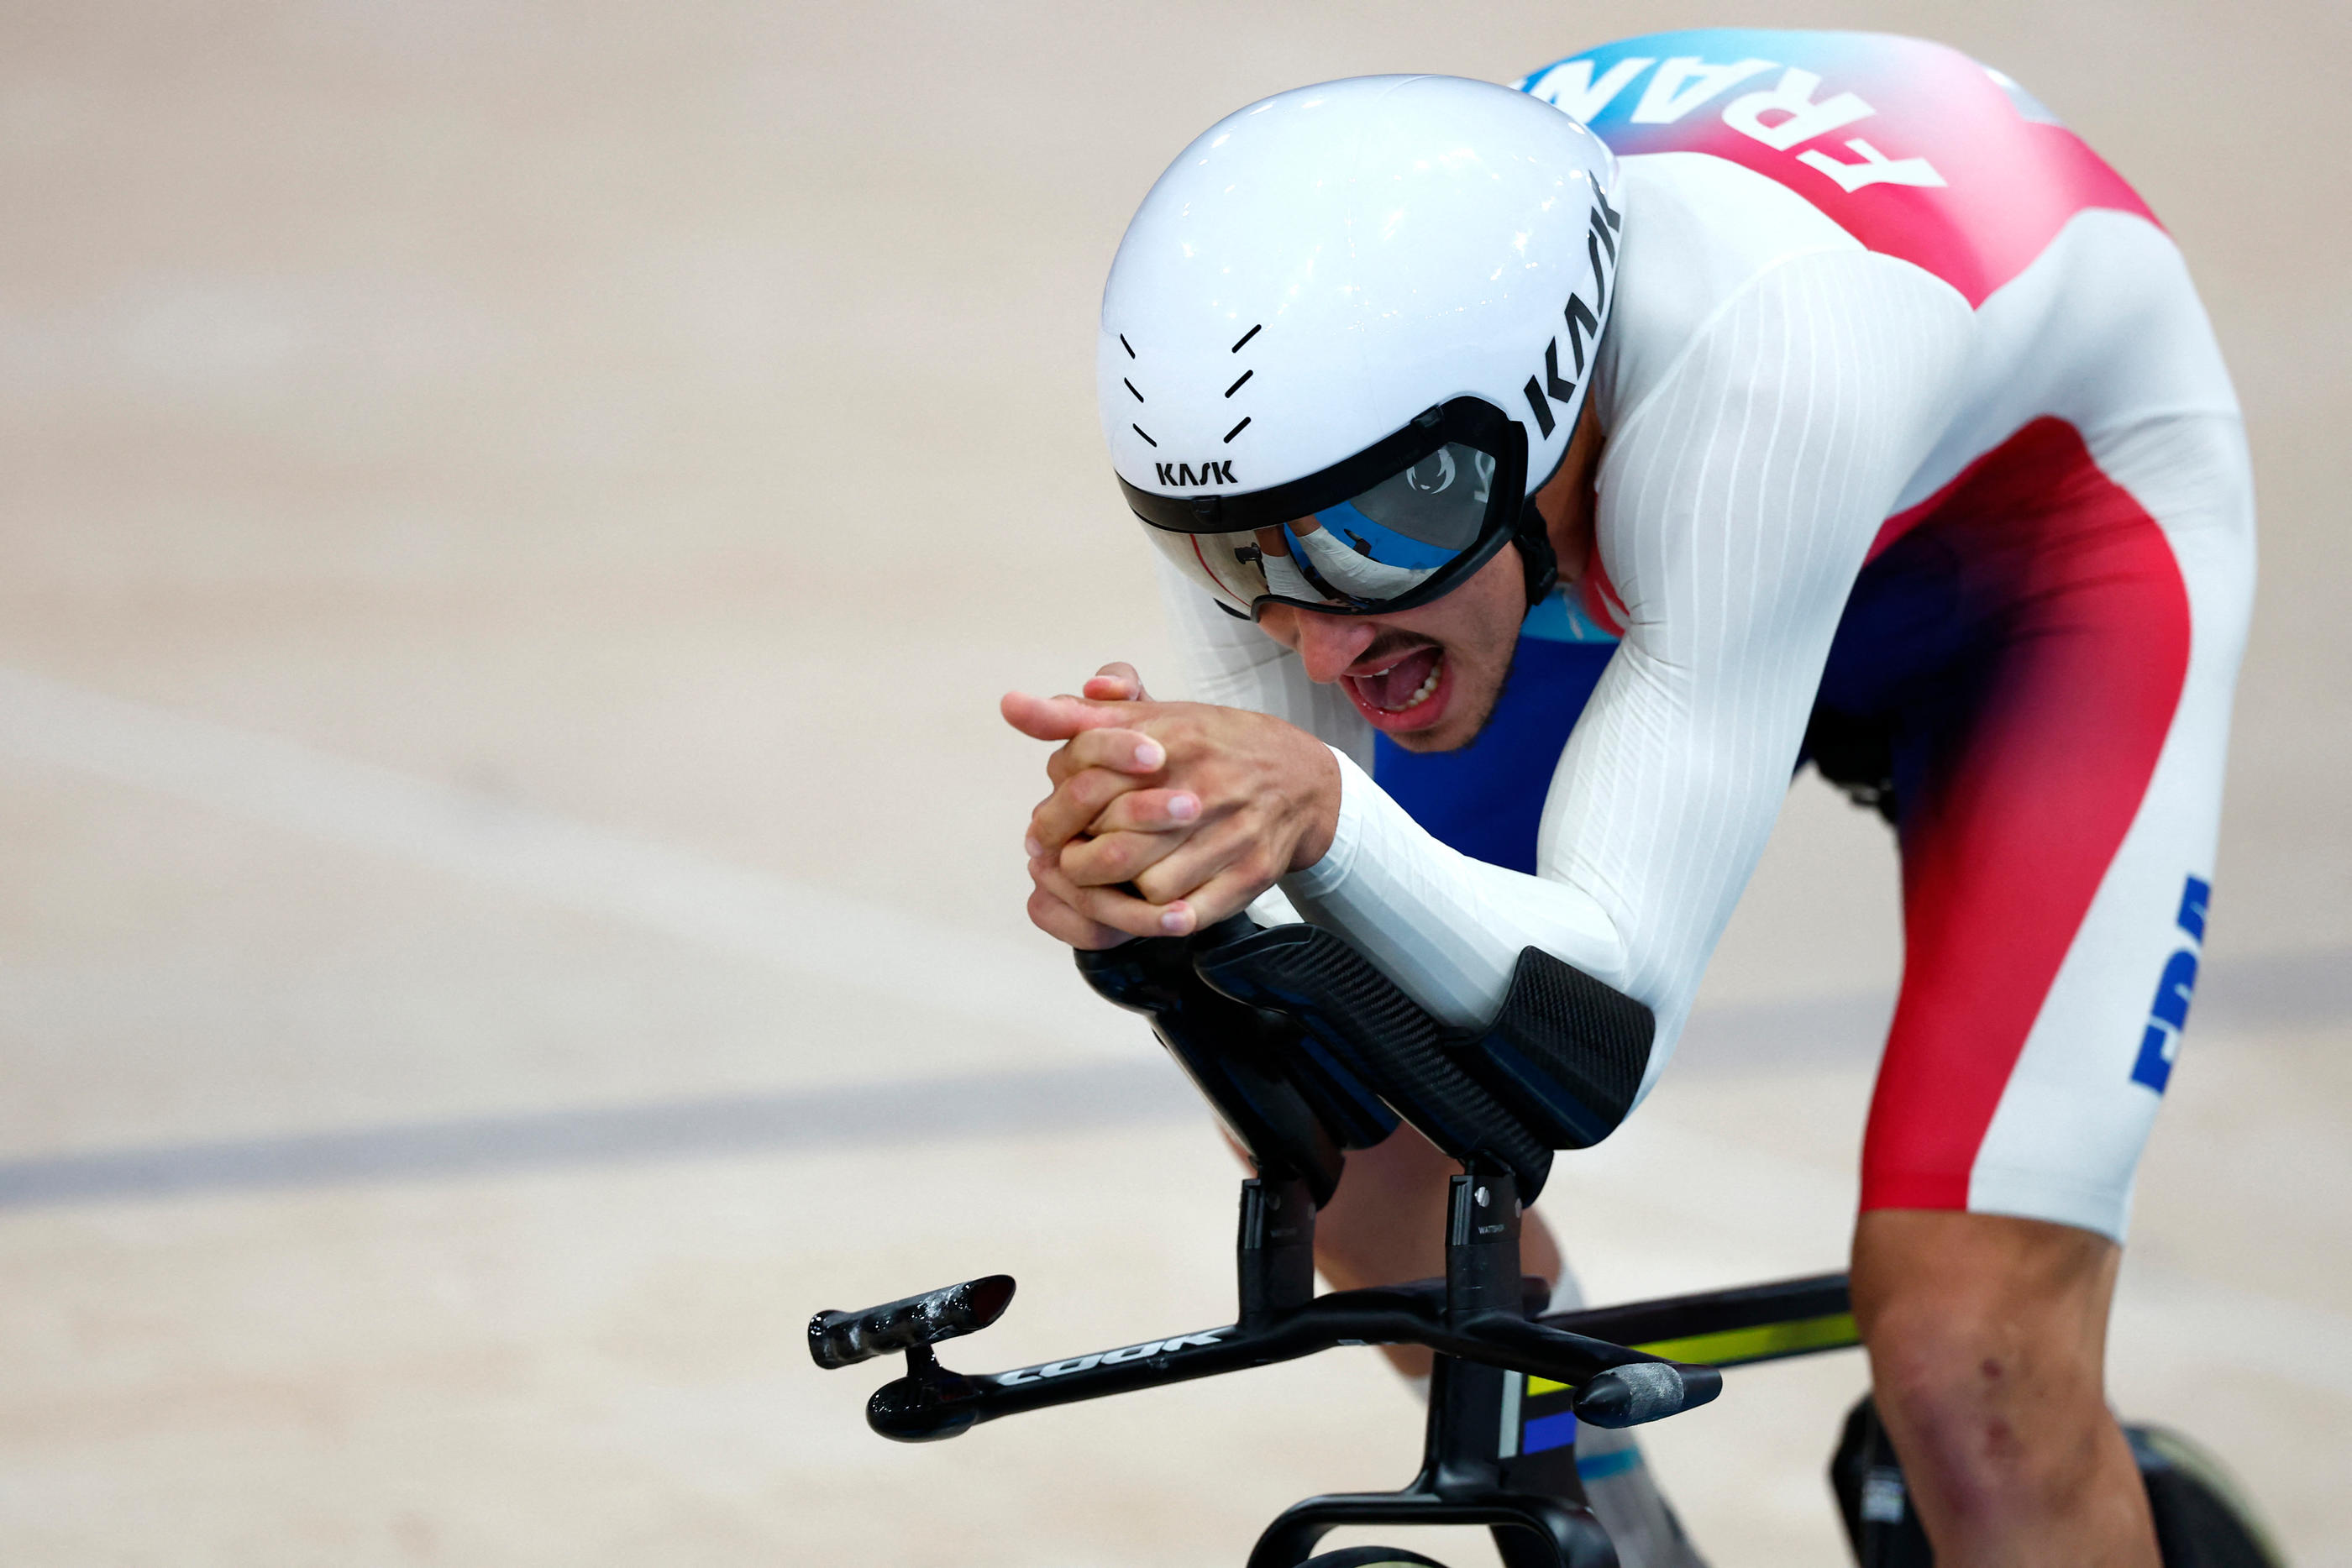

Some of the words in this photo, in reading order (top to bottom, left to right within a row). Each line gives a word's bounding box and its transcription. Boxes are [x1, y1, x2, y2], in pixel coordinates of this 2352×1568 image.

[1508, 57, 1948, 193] FRAN
[1523, 170, 1620, 441] KASK
[1155, 460, 1238, 486] KASK
[997, 1327, 1232, 1386] LOOK
